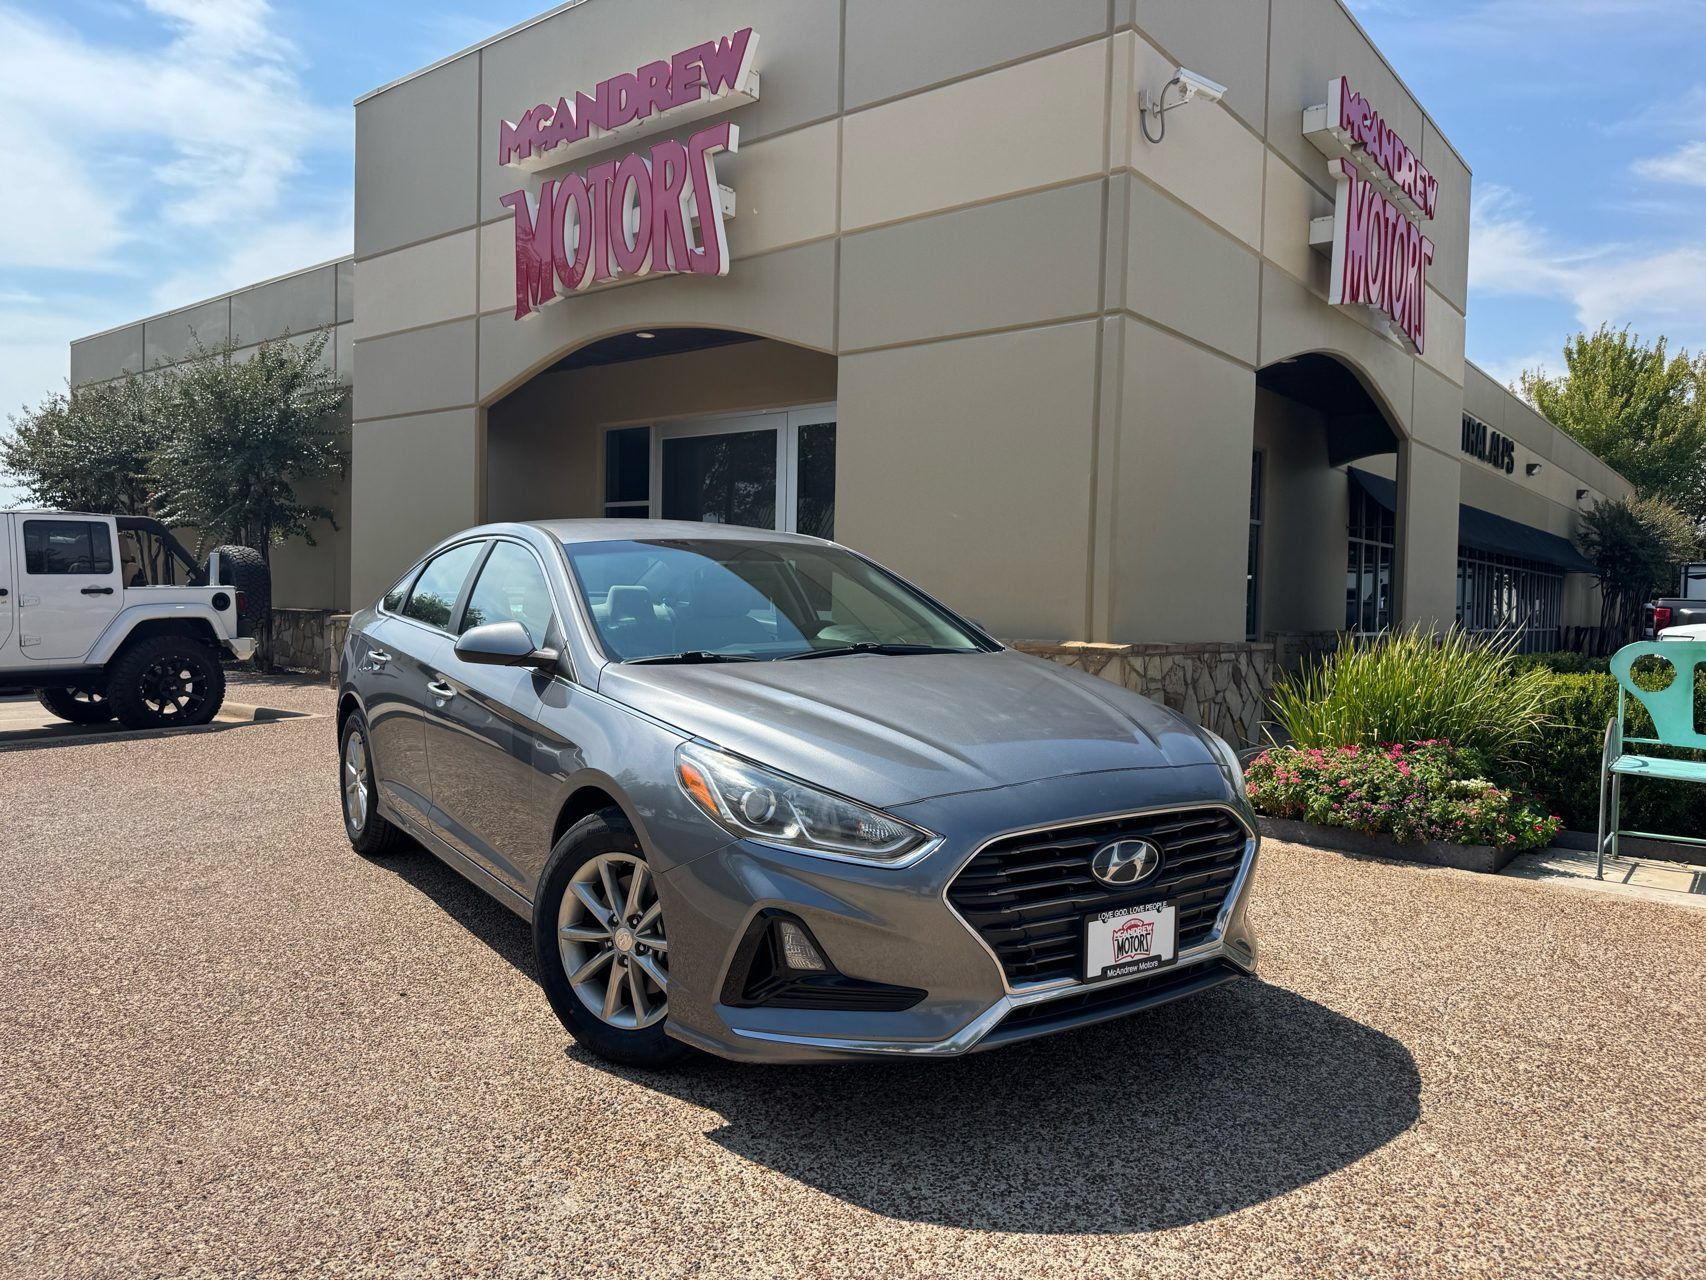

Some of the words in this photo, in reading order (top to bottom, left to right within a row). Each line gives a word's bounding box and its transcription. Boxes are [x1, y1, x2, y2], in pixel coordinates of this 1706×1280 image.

[499, 121, 733, 322] MOTORS
[1339, 157, 1436, 356] MOTORS
[1098, 911, 1114, 921] LOVE
[1129, 905, 1145, 915] LOVE
[1114, 932, 1151, 959] MOTORS
[1107, 965, 1138, 977] McAndrew
[1138, 960, 1158, 971] Motors
